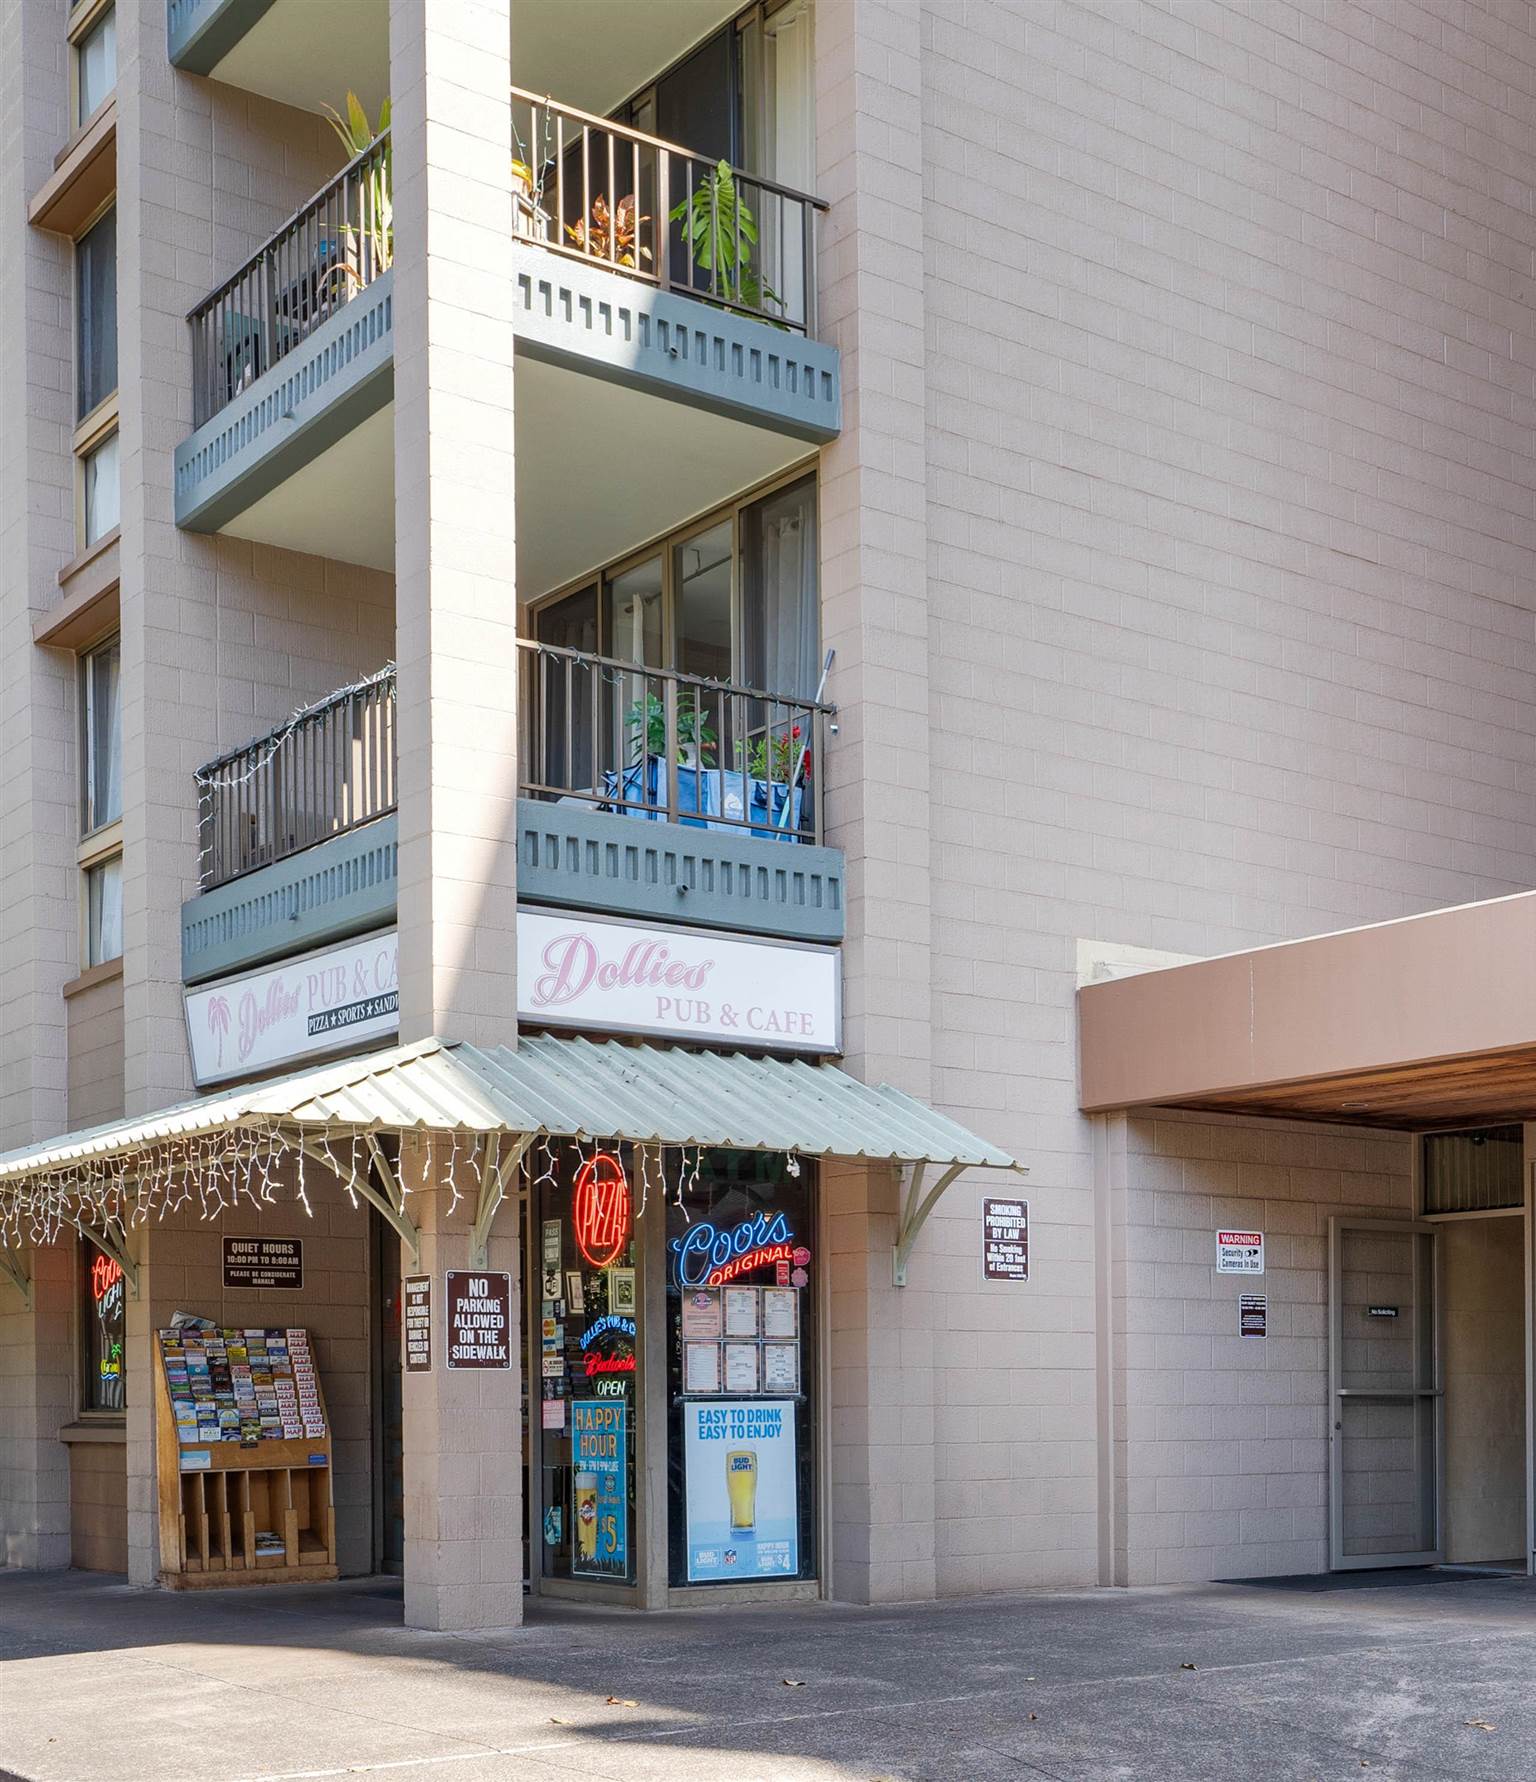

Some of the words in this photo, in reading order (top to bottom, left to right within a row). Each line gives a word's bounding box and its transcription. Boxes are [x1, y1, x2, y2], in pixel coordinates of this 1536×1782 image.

[532, 931, 715, 1007] Dollies
[307, 965, 346, 1012] PUB
[352, 959, 369, 996] &
[308, 1015, 330, 1034] PIZZA
[338, 1003, 366, 1026] SPORTS
[656, 996, 711, 1025] PUB
[720, 1003, 739, 1026] &
[747, 1005, 815, 1036] CAFE
[990, 1204, 1021, 1216] SMOKING
[986, 1215, 1026, 1229] PROHIBITED
[992, 1227, 1002, 1238] BY
[1004, 1228, 1020, 1240] LAW
[1220, 1234, 1260, 1245] WARNING
[232, 1242, 259, 1254] QUIET
[262, 1243, 294, 1254] HOURS
[673, 1210, 794, 1285] Coors
[990, 1244, 998, 1252] No
[999, 1244, 1023, 1255] Smoking
[1222, 1248, 1243, 1258] Security
[227, 1256, 246, 1264] 10:00
[247, 1256, 258, 1264] PM
[260, 1256, 269, 1264] TO
[709, 1246, 793, 1286] ORIGINAL
[1222, 1259, 1243, 1268] Cameras
[1244, 1260, 1249, 1268] In
[1250, 1260, 1259, 1269] Use
[92, 1256, 122, 1298] Coo
[468, 1278, 488, 1297] NO
[456, 1298, 501, 1313] PARKING
[453, 1314, 504, 1329] ALLOWED
[460, 1330, 475, 1344] ON
[477, 1330, 499, 1344] THE
[452, 1345, 507, 1360] SIDEWALK
[597, 1381, 626, 1395] OPEN
[575, 1408, 622, 1431] HAPPY
[698, 1410, 727, 1424] EASY
[730, 1410, 745, 1424] TO
[747, 1409, 782, 1423] DRINK
[699, 1425, 728, 1440] EASY
[730, 1424, 745, 1439] TO
[747, 1424, 782, 1438] ENJOY
[580, 1434, 617, 1457] HOUR
[733, 1457, 749, 1465] BUD
